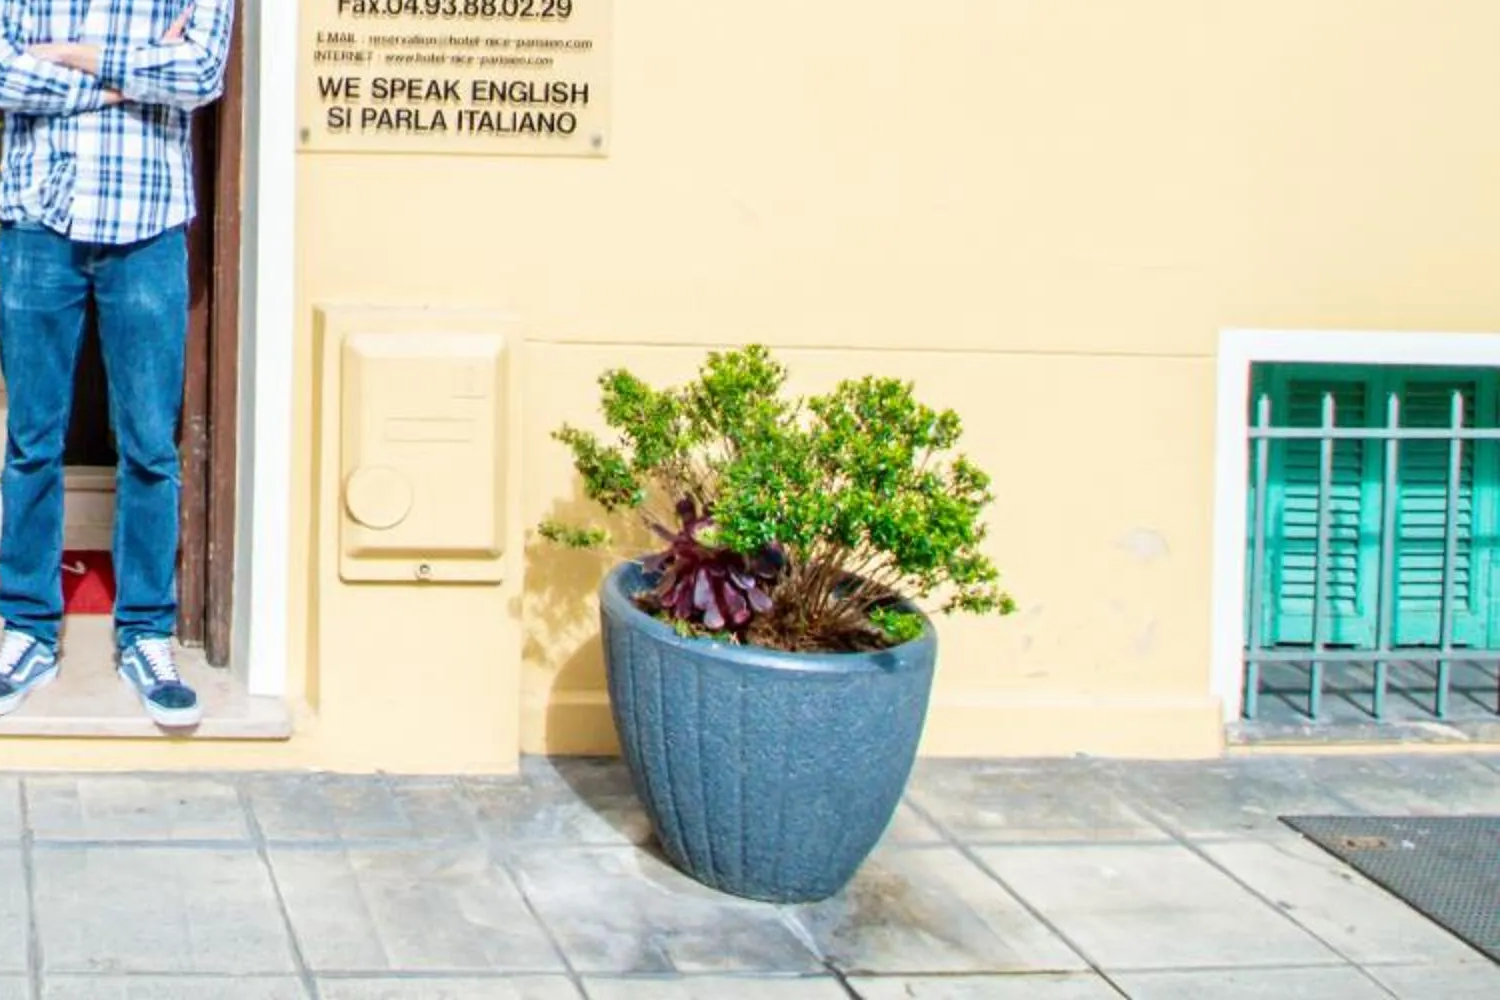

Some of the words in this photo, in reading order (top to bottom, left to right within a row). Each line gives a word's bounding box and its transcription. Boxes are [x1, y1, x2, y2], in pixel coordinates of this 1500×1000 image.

[317, 76, 361, 99] WE
[370, 77, 461, 101] SPEAK
[471, 80, 589, 105] ENGLISH
[326, 106, 352, 129] SI
[361, 107, 448, 132] PARLA
[456, 109, 578, 134] ITALIANO
